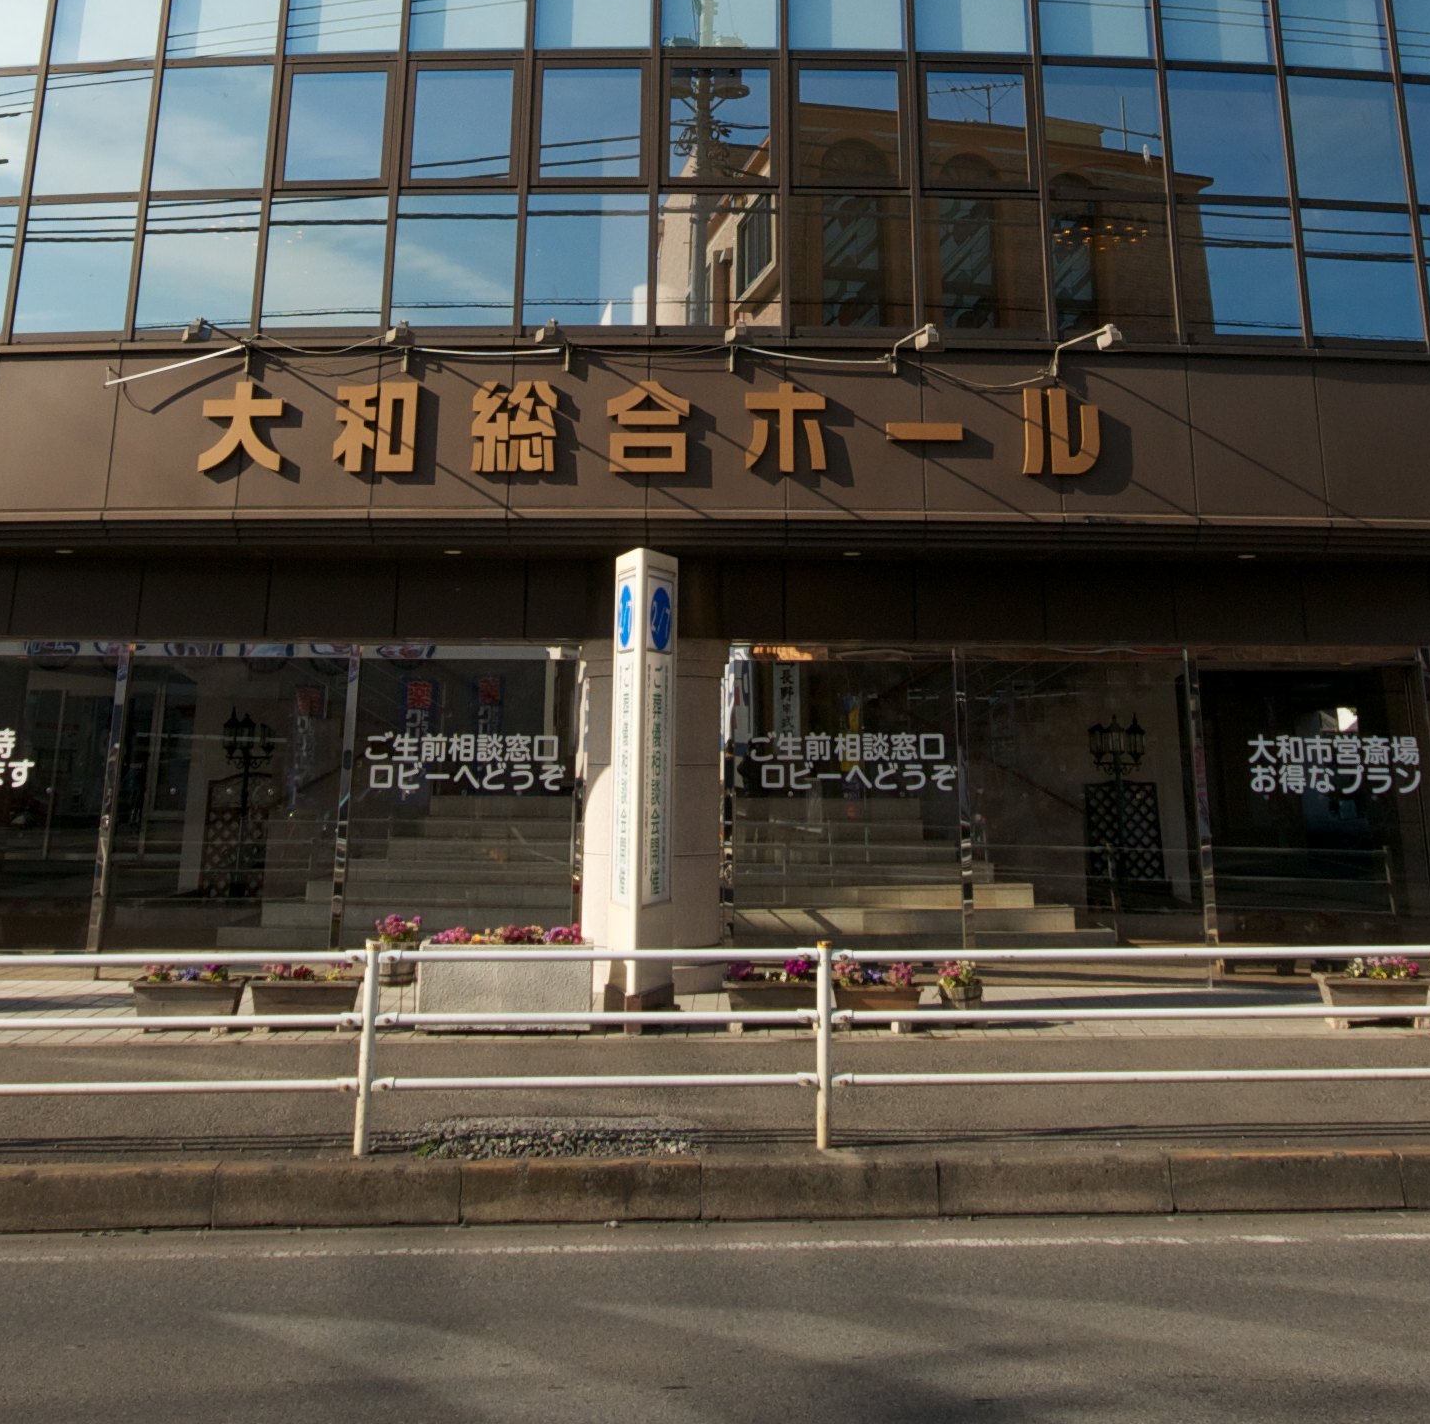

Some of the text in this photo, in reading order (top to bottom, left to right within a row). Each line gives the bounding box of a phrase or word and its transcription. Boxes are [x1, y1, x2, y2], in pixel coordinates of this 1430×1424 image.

[197, 380, 1100, 475] 大和総合ホール
[364, 732, 559, 763] ご生前相談窓口
[750, 731, 945, 762] ご生前相談窓口
[1247, 734, 1420, 766] 大和市営斎場
[370, 763, 566, 791] ロビーへどうぞ
[761, 763, 959, 791] ロビーへどうぞ
[1250, 764, 1421, 794] お得なプラン
